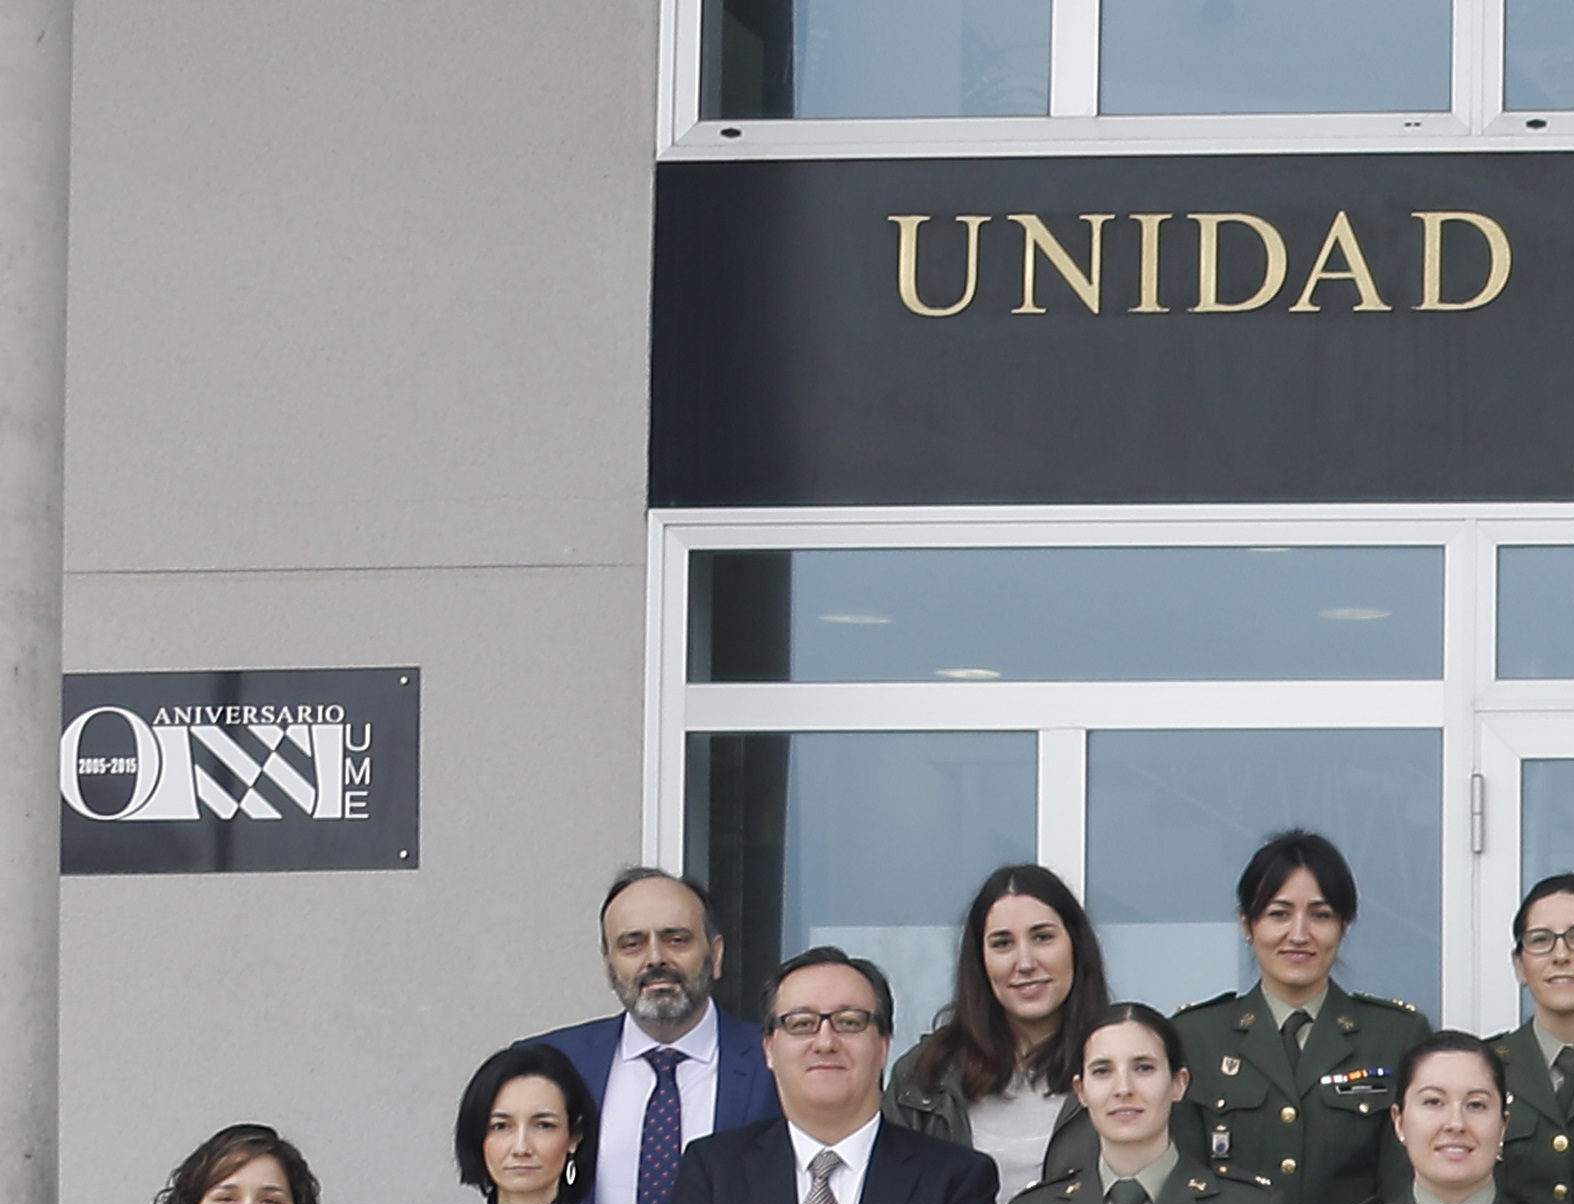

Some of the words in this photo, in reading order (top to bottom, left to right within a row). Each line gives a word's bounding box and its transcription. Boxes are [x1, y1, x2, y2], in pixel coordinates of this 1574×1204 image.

[896, 211, 1513, 316] UNIDAD
[152, 704, 346, 726] ANIVERSARIO
[78, 757, 138, 775] 2005-2015
